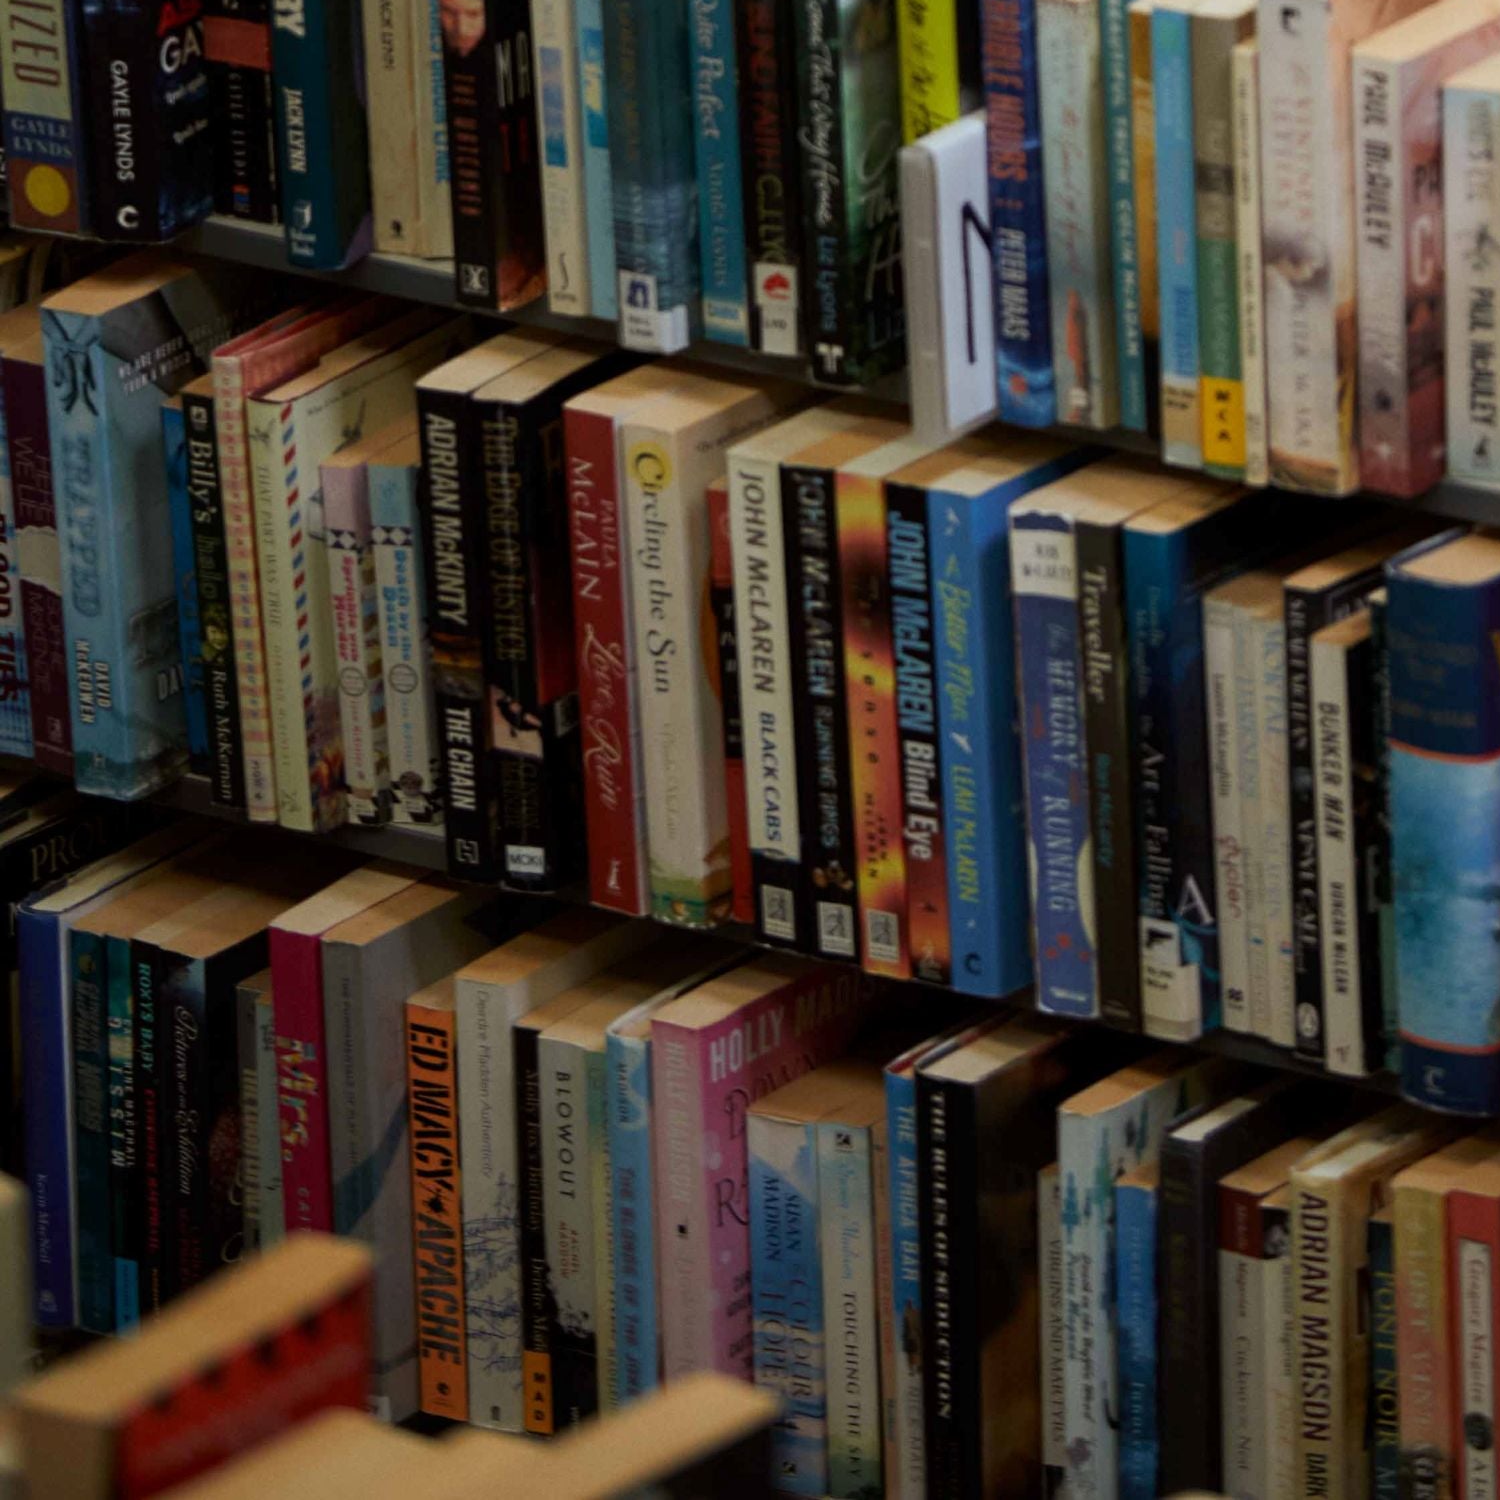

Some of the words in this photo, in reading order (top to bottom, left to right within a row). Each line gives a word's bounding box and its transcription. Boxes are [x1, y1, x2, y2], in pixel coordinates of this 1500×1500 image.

[110, 59, 130, 118] GAYLE
[282, 86, 302, 127] JACK
[698, 56, 725, 140] Perfect
[1363, 70, 1387, 126] PAUL
[10, 116, 71, 138] GAYLE
[12, 137, 73, 160] LYNDS
[114, 123, 135, 182] LYNDS
[287, 128, 306, 174] LYNN
[987, 95, 1027, 182] HOURS
[1365, 139, 1391, 252] McAULEY
[1000, 227, 1027, 281] PETER
[1003, 284, 1030, 342] MAAS
[1471, 286, 1494, 333] PAUL
[1472, 342, 1498, 427] McAULEY
[188, 439, 215, 524] Billy's
[426, 413, 458, 511] ADRIAN
[637, 452, 673, 571] Circling
[740, 470, 768, 549] JOHN
[62, 434, 99, 617] TRAPPED
[94, 660, 112, 708] DAVID
[196, 534, 219, 600] halo
[433, 514, 468, 627] McKINTY
[887, 512, 926, 597] JOHN
[647, 578, 669, 621] the
[748, 556, 776, 694] McLAREN
[75, 639, 95, 725] McKEOWEN
[209, 670, 229, 709] Ruth
[647, 630, 676, 695] Sun
[894, 600, 934, 732] McLAREN
[214, 713, 235, 800] McKernan
[445, 707, 472, 744] THE
[759, 711, 779, 780] BLACK
[447, 746, 476, 811] CHAIN
[903, 740, 938, 810] Blind
[764, 786, 783, 842] CABS
[908, 814, 943, 860] Eye
[410, 1022, 449, 1072] ED
[277, 1036, 320, 1162] Mrs.
[896, 1106, 916, 1151] THE
[929, 1092, 947, 1139] THE
[412, 1079, 456, 1194] MACY
[35, 1173, 49, 1207] Kevin
[555, 1071, 576, 1200] BLOWOUT
[569, 1229, 579, 1275] RACHEL
[897, 1156, 917, 1230] AFRICA
[931, 1148, 948, 1226] RULES
[558, 1221, 570, 1280] MADDOW
[901, 1240, 919, 1283] BAR
[933, 1231, 949, 1268] OF
[1299, 1193, 1329, 1303] ADRIAN
[417, 1213, 461, 1365] APACHE
[843, 1292, 860, 1395] TOUCHING
[935, 1273, 952, 1419] SEDUCTION
[1301, 1316, 1333, 1443] MAGSON
[845, 1402, 861, 1440] THE
[848, 1445, 863, 1479] SKY
[1304, 1452, 1330, 1499] DARK
